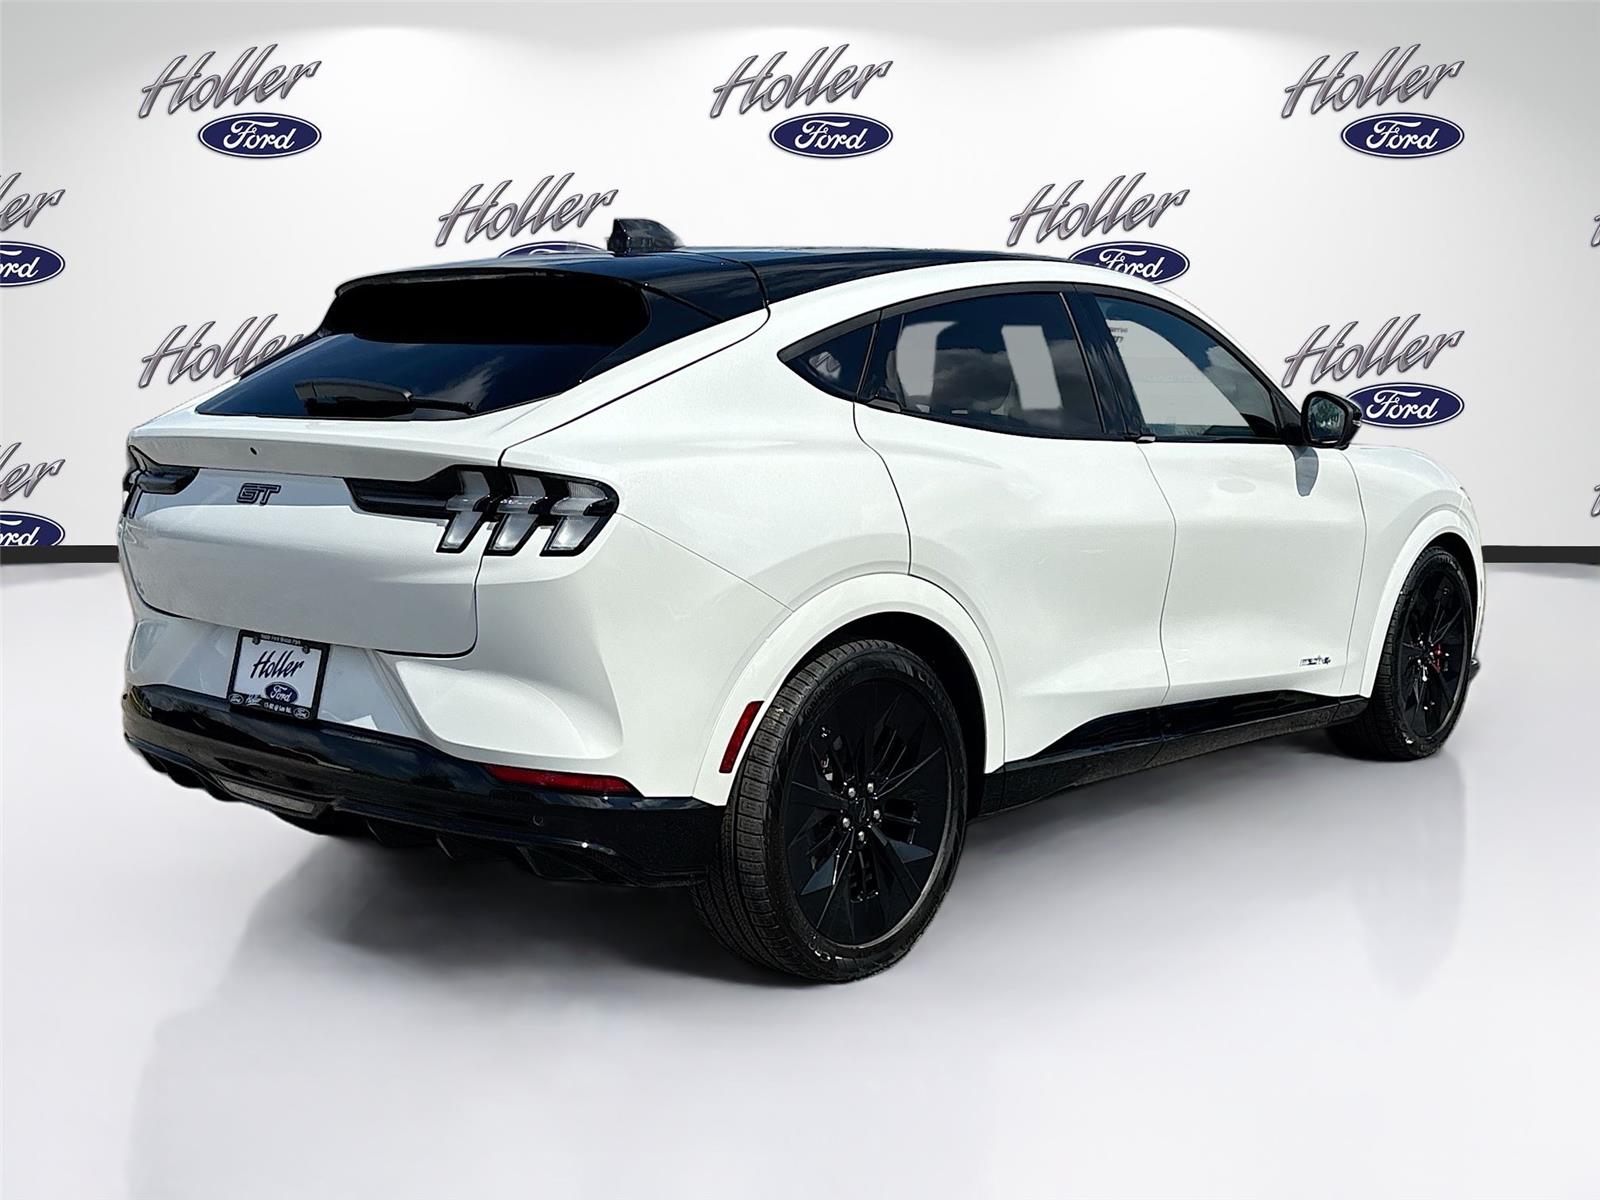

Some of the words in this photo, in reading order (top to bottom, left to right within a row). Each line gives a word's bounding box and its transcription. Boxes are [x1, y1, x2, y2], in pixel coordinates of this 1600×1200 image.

[138, 44, 322, 118] Holler
[709, 44, 893, 118] Holler
[1281, 44, 1465, 118] Holler
[223, 119, 297, 150] Ford
[794, 119, 868, 150] Ford
[1366, 119, 1440, 150] Ford
[435, 172, 618, 247] Holler
[1007, 172, 1190, 247] Holler
[0, 250, 40, 278] rd
[138, 313, 304, 388] Holle
[1281, 313, 1465, 388] Holler
[1366, 389, 1440, 420] Ford
[237, 483, 281, 505] GT
[250, 650, 304, 678] Holler
[269, 685, 292, 702] Ford
